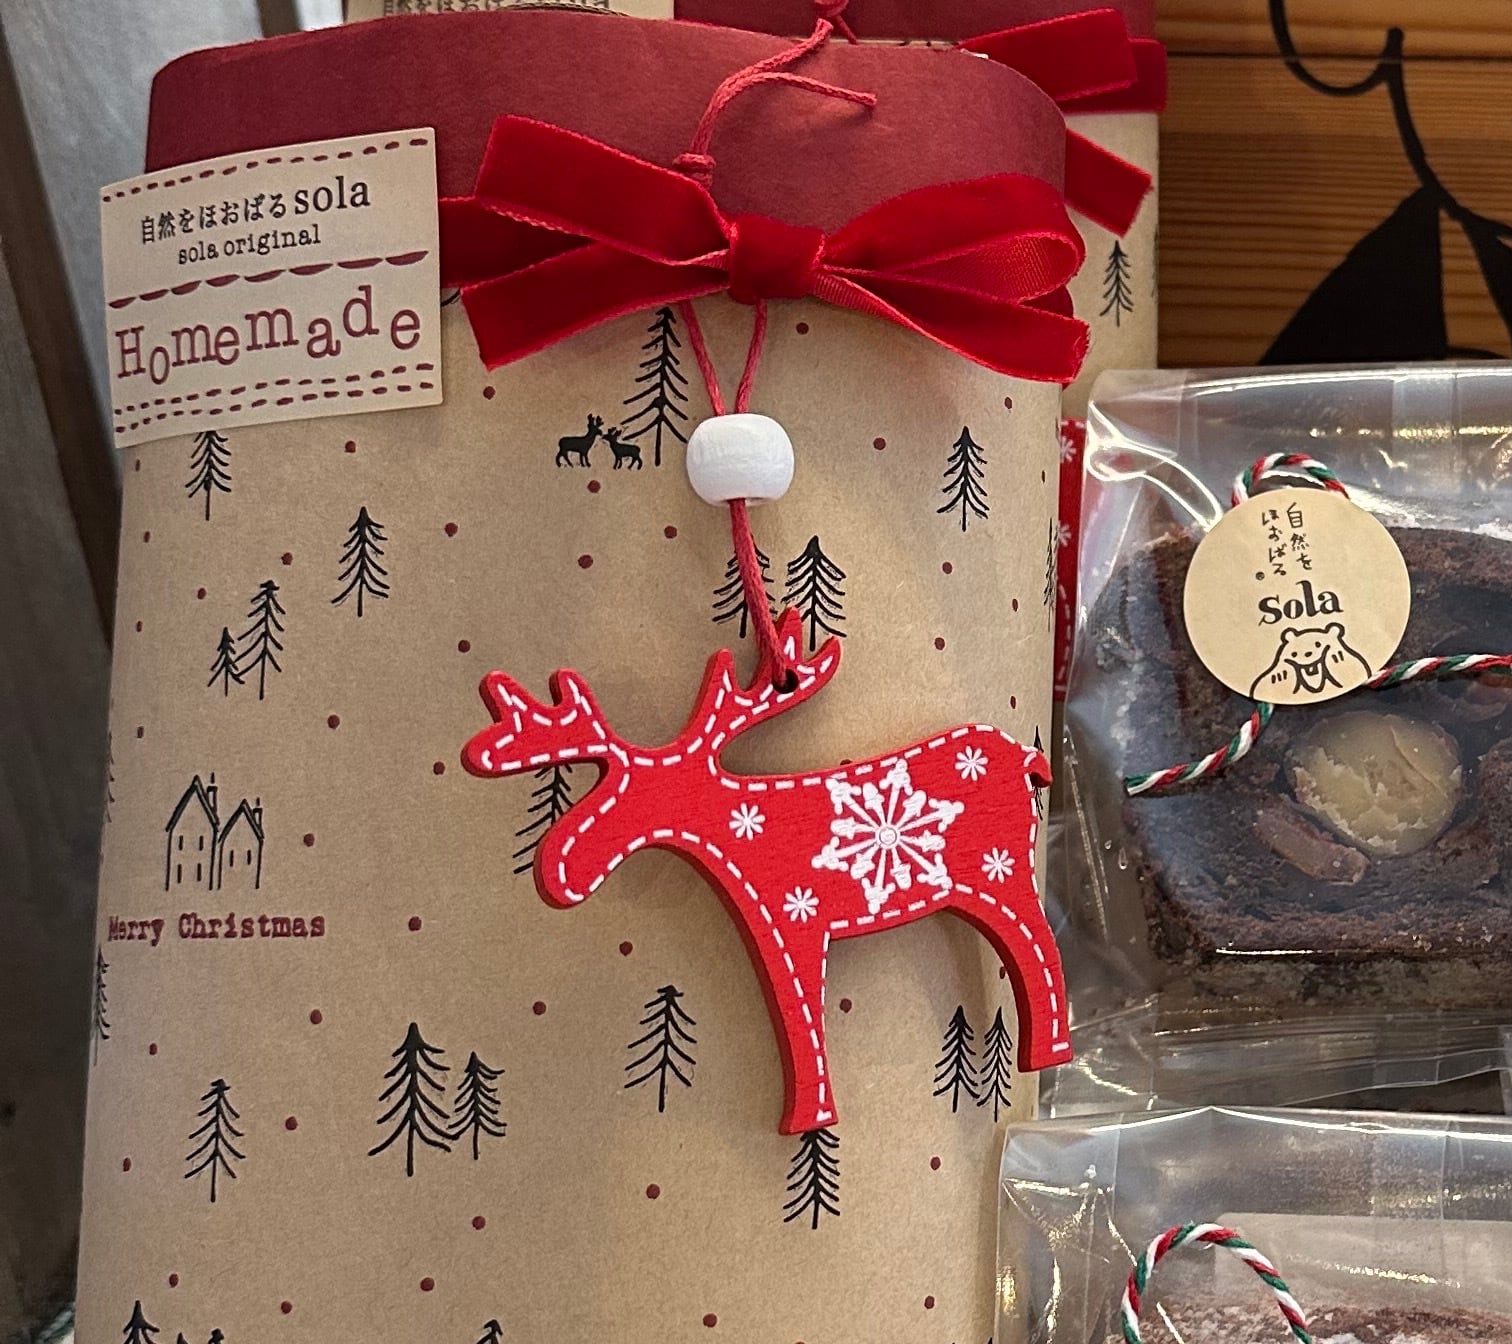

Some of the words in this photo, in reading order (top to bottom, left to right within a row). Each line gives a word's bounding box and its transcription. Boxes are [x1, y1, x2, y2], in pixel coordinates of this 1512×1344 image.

[295, 176, 370, 215] sola
[178, 241, 219, 265] sola
[224, 224, 321, 256] original
[114, 285, 420, 385] Homemade
[1286, 502, 1312, 570] 自然を
[107, 916, 164, 947] Merry
[178, 912, 325, 939] Christmas
